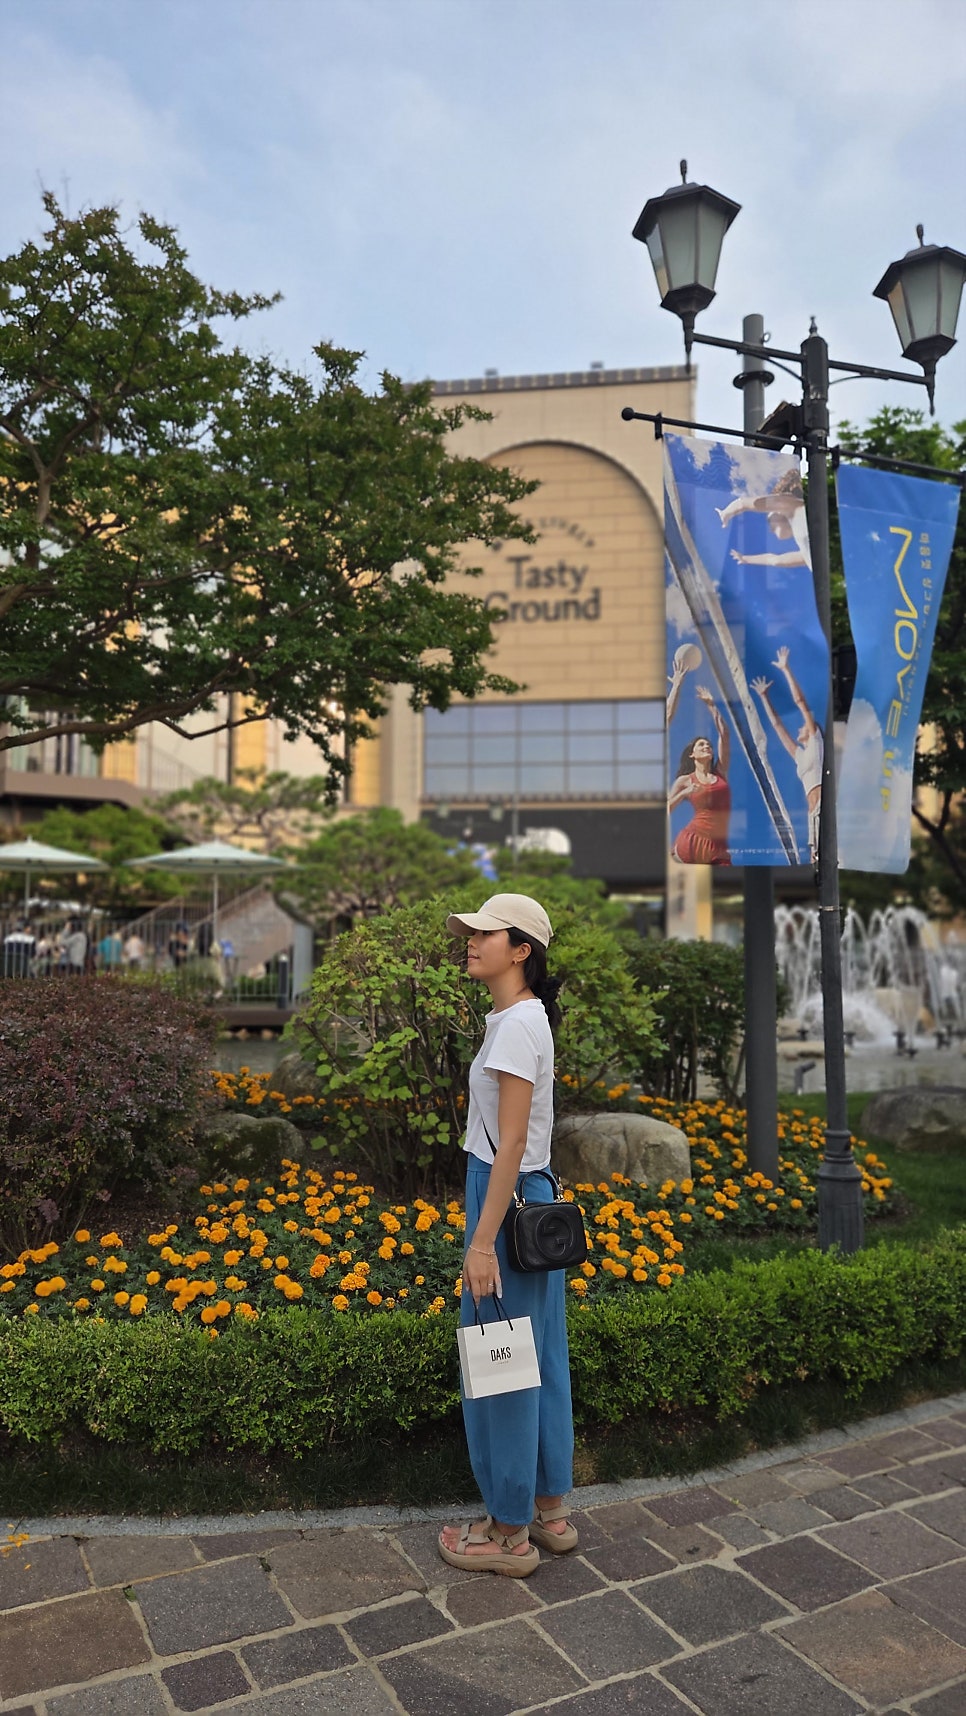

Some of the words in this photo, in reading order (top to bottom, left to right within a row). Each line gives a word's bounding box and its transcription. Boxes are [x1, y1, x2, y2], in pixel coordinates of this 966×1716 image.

[506, 555, 589, 594] Tasty
[485, 587, 602, 624] Ground
[886, 526, 919, 738] MOVE
[490, 1346, 512, 1362] DAKS
